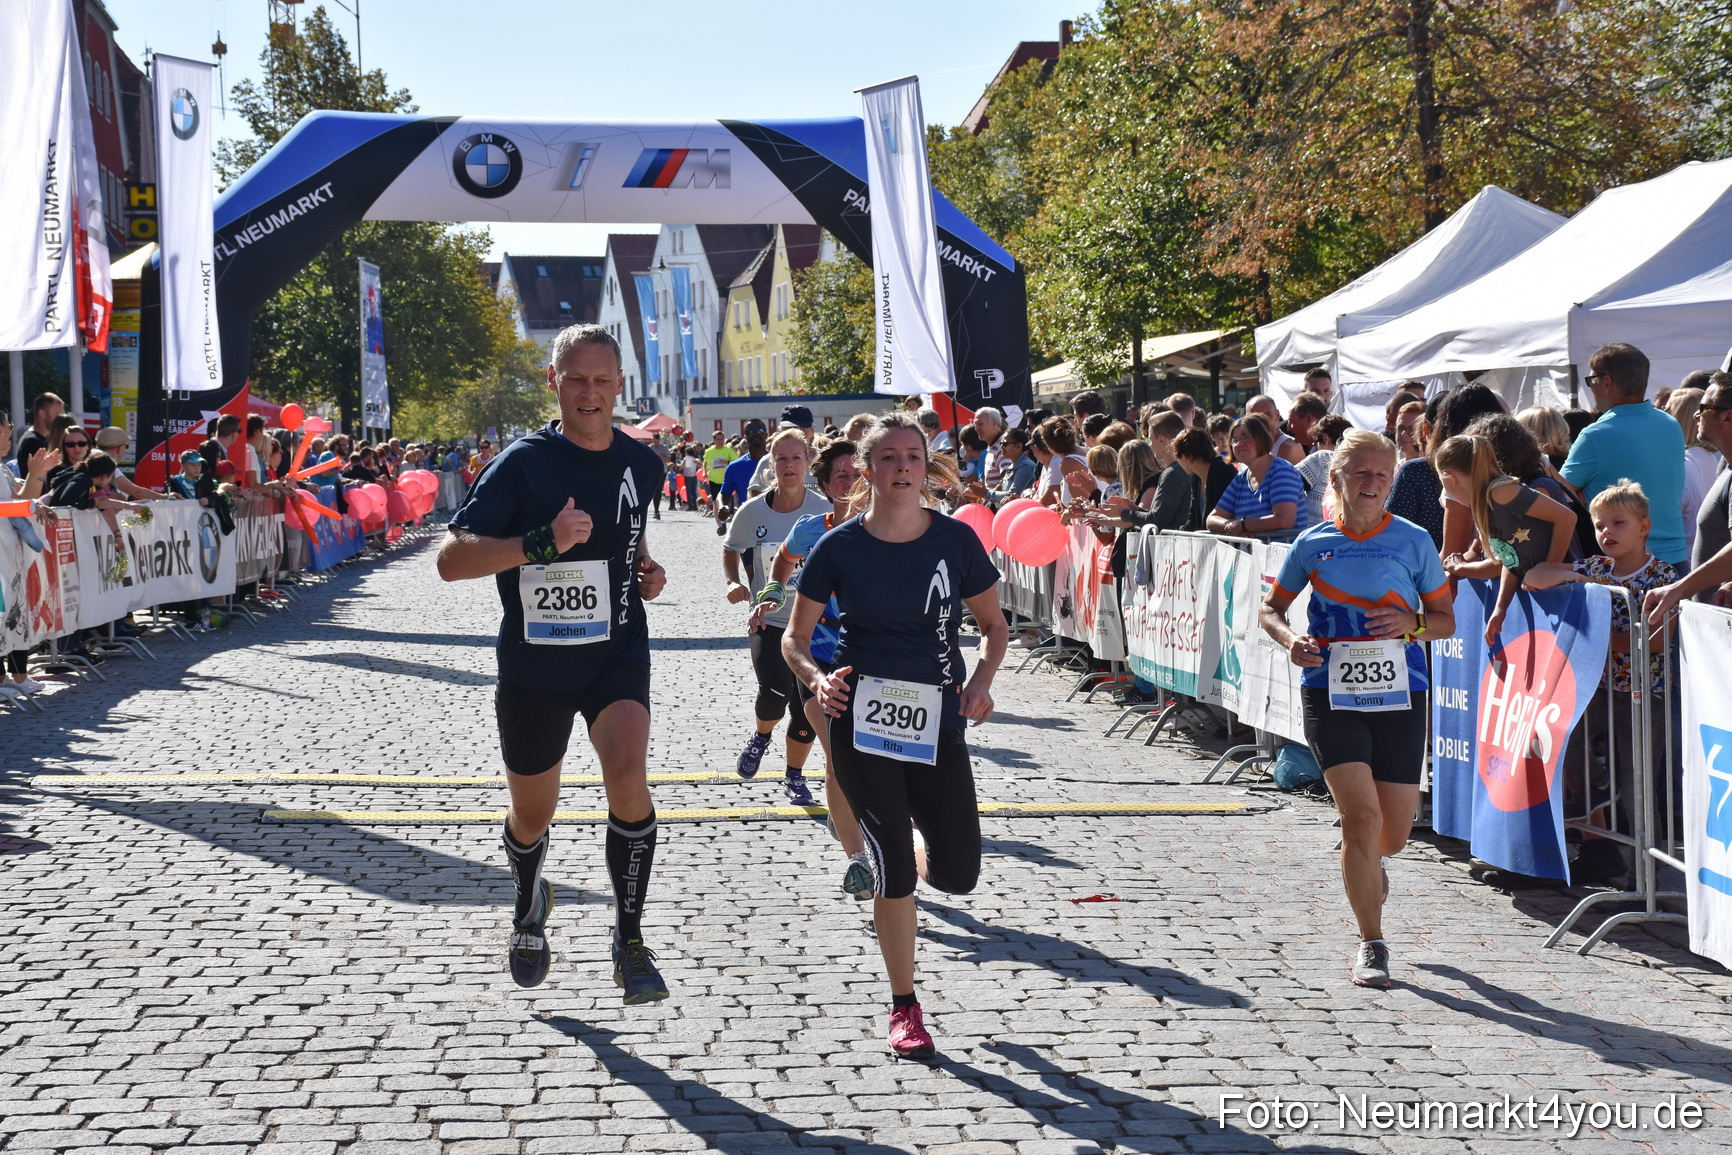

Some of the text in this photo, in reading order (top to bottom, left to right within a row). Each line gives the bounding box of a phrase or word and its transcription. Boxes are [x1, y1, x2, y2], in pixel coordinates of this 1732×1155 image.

[460, 133, 516, 154] BMW
[233, 181, 335, 249] NEUMARKT
[44, 138, 62, 333] PARTL NEUMARKT
[200, 259, 218, 380] PARTL NEARKT
[152, 425, 188, 434] 100 EARS
[546, 569, 584, 580] BOCK
[534, 585, 598, 611] 2386
[549, 626, 586, 637] Jochen
[1350, 647, 1385, 657] BOCK
[1435, 636, 1464, 660] STORE
[1340, 660, 1396, 684] 2333
[882, 685, 919, 700] BOCK
[1355, 696, 1384, 706] Conny
[865, 699, 928, 732] 2390
[869, 726, 913, 740] PARTL Neumarkt
[883, 740, 903, 753] Rita
[1436, 735, 1470, 763] OBILE
[622, 839, 649, 914] Kalenji
